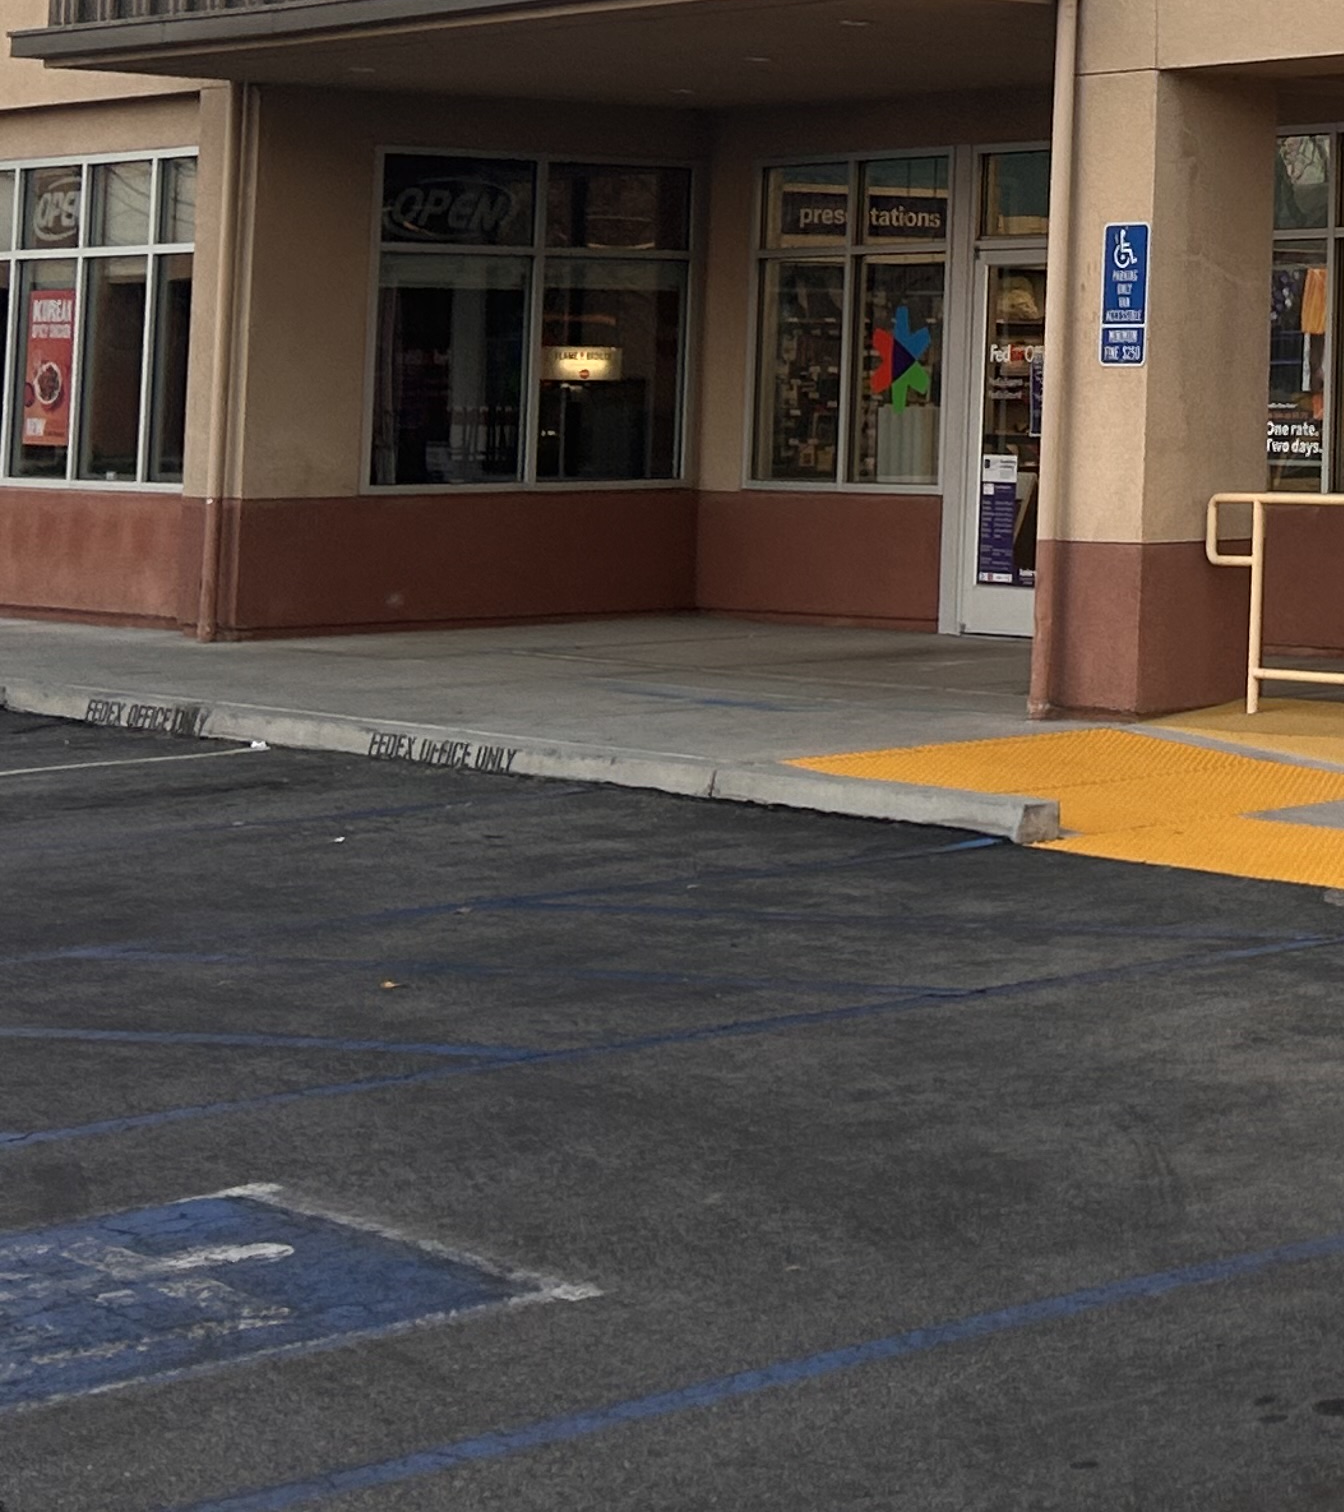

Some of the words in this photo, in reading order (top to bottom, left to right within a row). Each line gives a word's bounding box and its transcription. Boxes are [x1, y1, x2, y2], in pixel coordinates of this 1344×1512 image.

[36, 191, 81, 229] OPE
[391, 187, 513, 232] OPEN
[799, 205, 942, 229] prestations
[1266, 420, 1290, 437] One
[1290, 421, 1320, 437] rate.
[1266, 438, 1290, 454] Two
[1290, 438, 1324, 458] days.
[86, 698, 127, 726] FEDEX
[127, 703, 176, 732] OFFICE
[368, 731, 418, 762] FEDEX
[418, 737, 474, 768] OFFICE
[473, 744, 522, 774] ONLY
